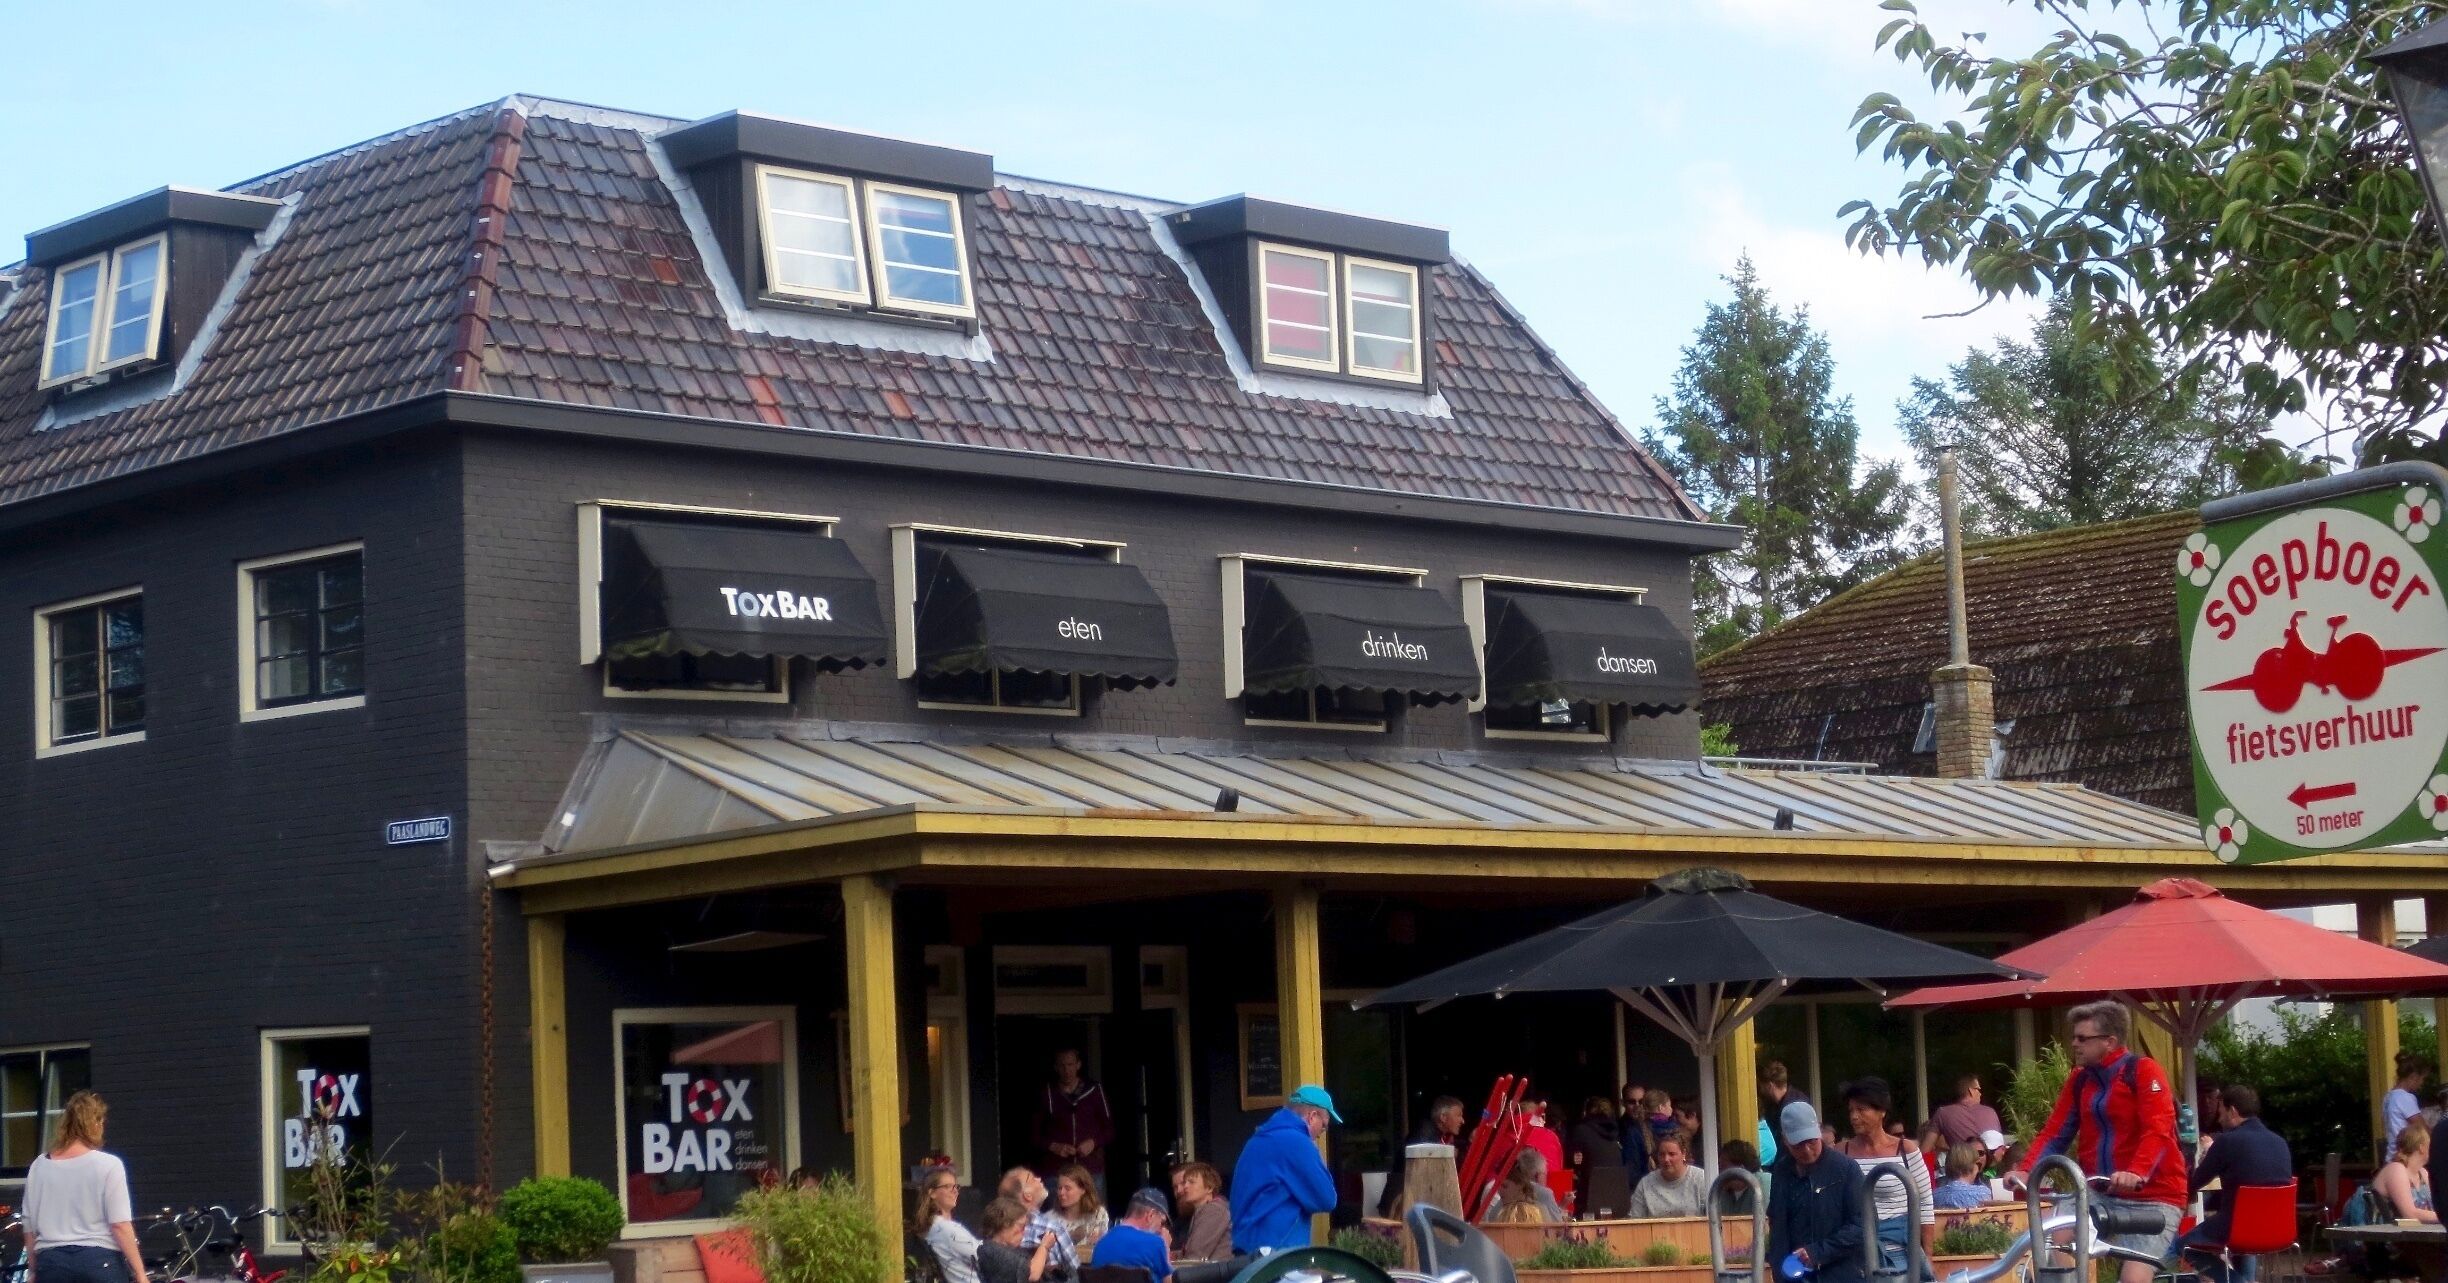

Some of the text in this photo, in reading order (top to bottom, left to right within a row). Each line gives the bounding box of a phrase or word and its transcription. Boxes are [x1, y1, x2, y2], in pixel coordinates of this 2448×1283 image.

[2206, 522, 2430, 641] soepboer
[1058, 616, 1102, 641] eten
[1362, 630, 1429, 661] drinken
[1597, 646, 1658, 675] dansen
[2226, 704, 2421, 764] fietsverhuur
[2296, 810, 2365, 836] 50 meter
[297, 1069, 362, 1120] TOX
[661, 1072, 754, 1124] TOX
[642, 1122, 734, 1174] BAR
[734, 1141, 769, 1155] drinken
